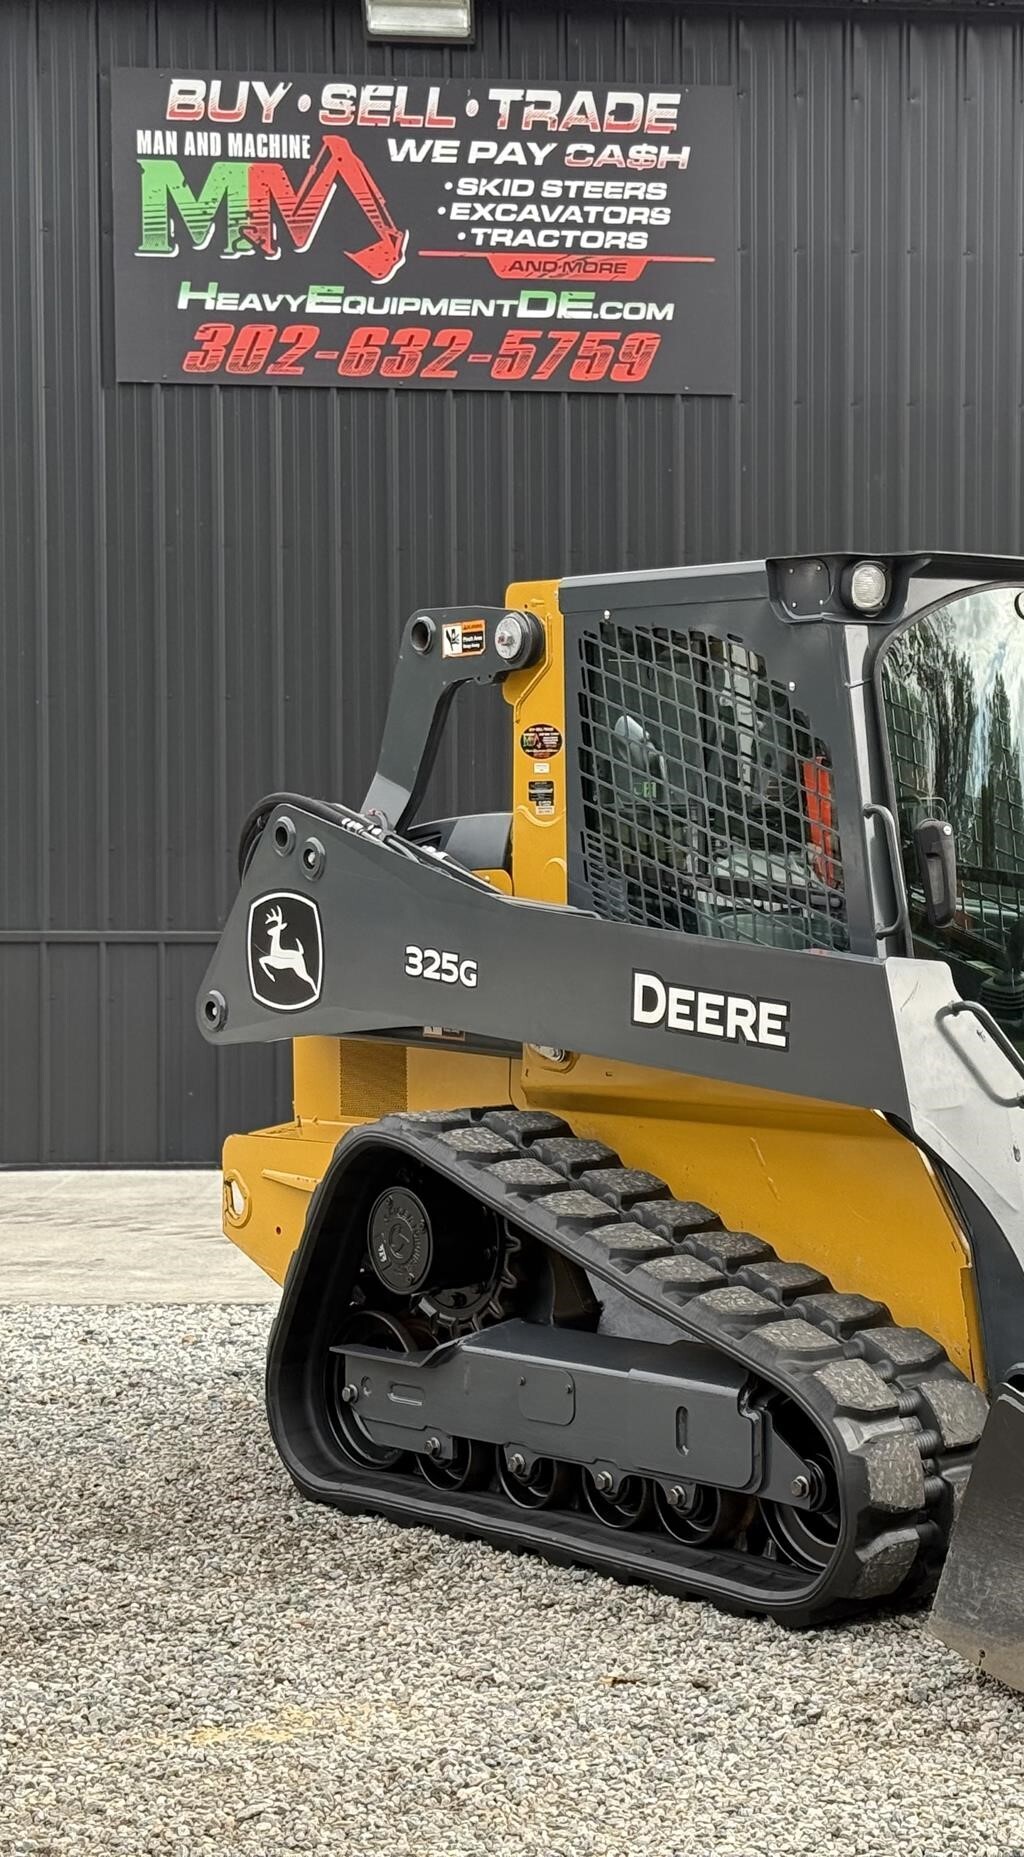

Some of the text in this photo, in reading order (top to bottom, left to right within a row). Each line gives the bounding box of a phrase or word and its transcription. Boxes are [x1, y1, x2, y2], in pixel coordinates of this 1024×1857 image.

[166, 78, 682, 134] BUY SELL TRADE
[136, 129, 311, 160] MAN AND MACHINE
[387, 138, 691, 170] WE PAY CA$H
[456, 177, 668, 200] SKID STEERS
[449, 202, 672, 225] EXCAVATORS
[470, 227, 649, 249] TRACTORS
[182, 322, 662, 382] 302-632-5759
[404, 944, 479, 988] 325G
[632, 971, 788, 1049] DEERE
